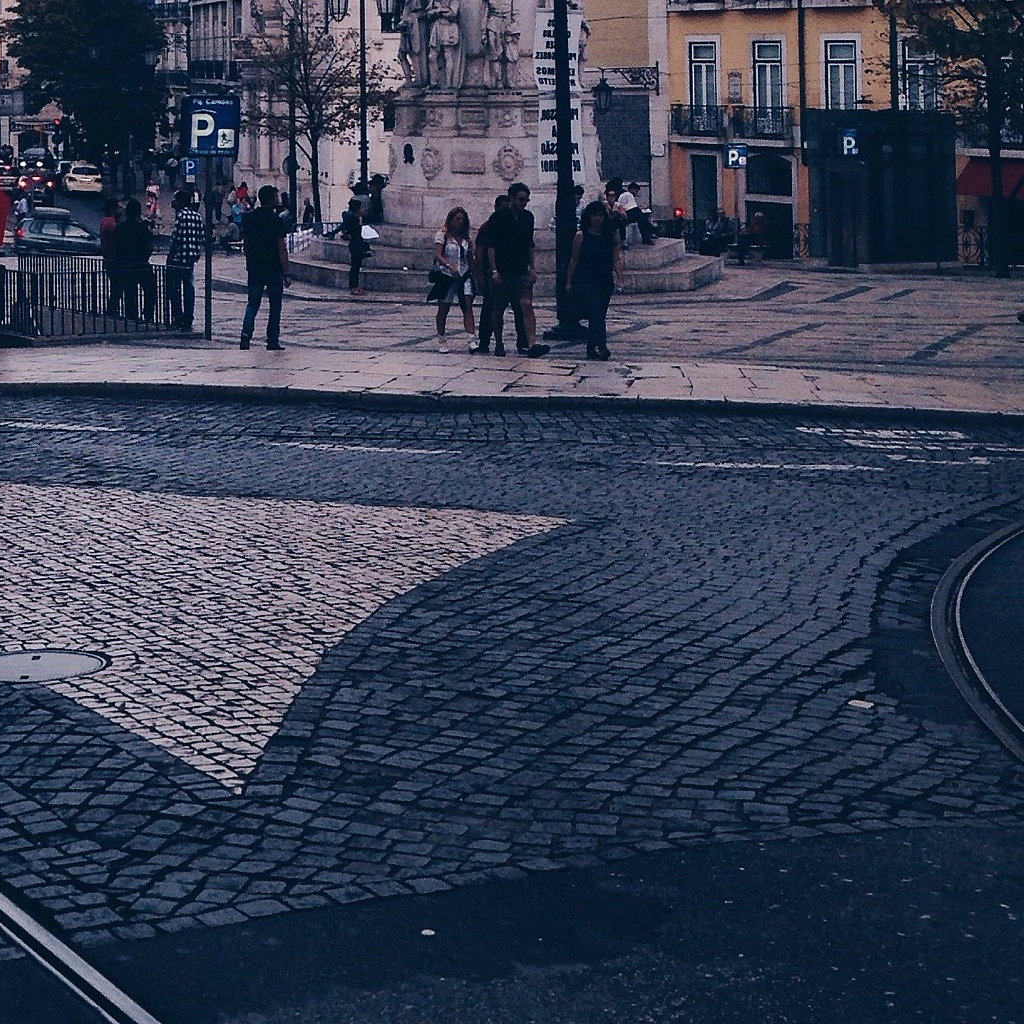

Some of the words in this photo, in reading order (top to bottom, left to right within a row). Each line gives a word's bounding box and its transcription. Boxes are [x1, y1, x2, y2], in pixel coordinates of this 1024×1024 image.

[190, 113, 215, 149] P
[842, 136, 856, 155] P
[728, 149, 739, 166] P
[185, 160, 195, 174] P
